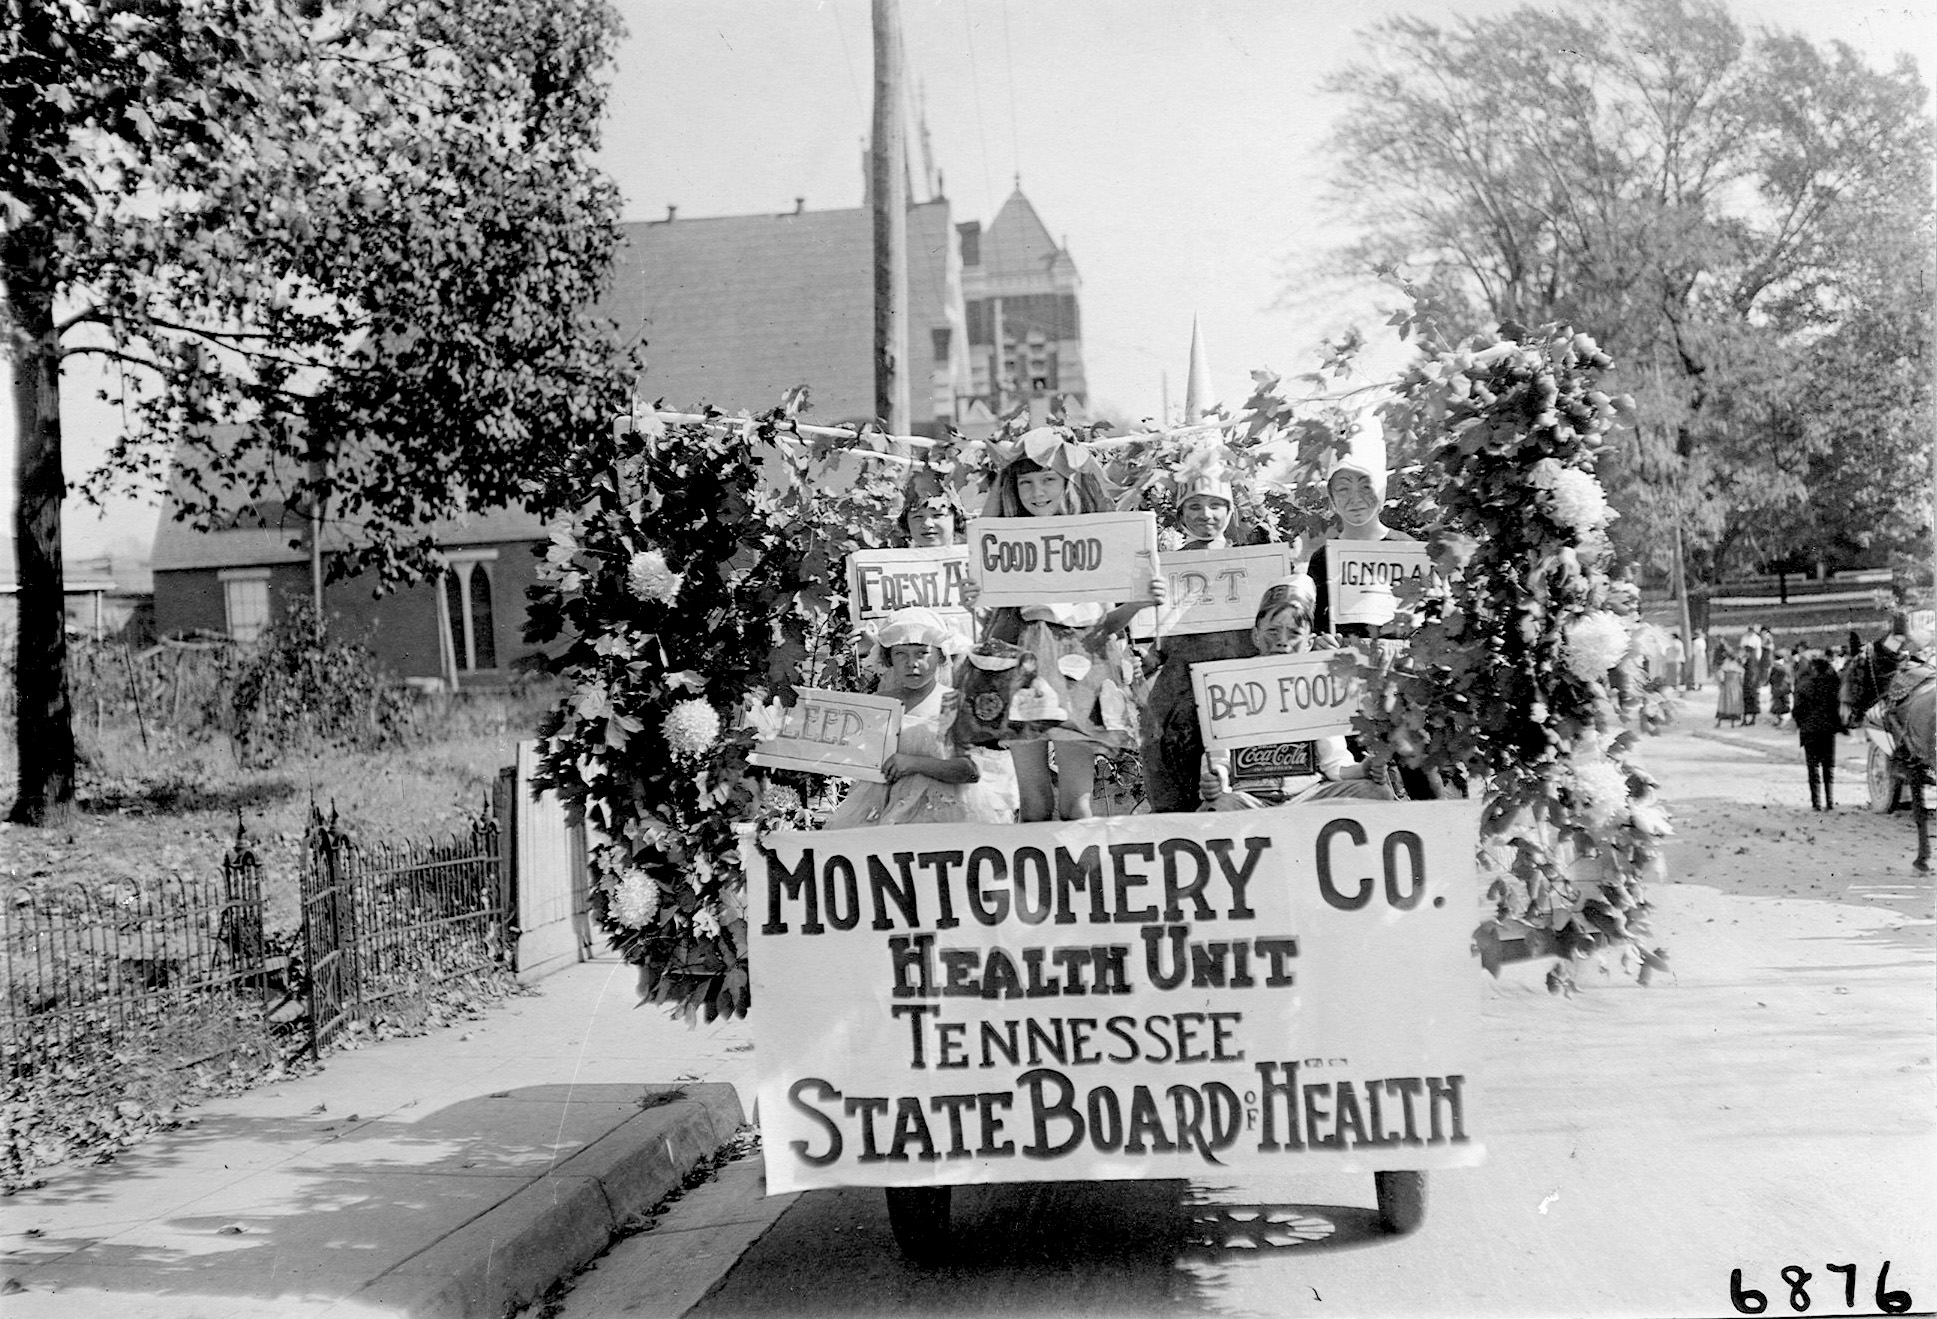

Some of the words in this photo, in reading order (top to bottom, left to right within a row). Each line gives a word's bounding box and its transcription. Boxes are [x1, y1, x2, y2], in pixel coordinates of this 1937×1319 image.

[981, 533, 1038, 573] GOOD
[1040, 534, 1103, 573] FOOD
[858, 566, 939, 611] FRESH
[1168, 567, 1249, 610] IRT
[1207, 681, 1268, 721] BAD
[1277, 673, 1349, 713] FOOD
[776, 704, 864, 746] LEEP
[760, 836, 1273, 936] MONTGOMERY
[1315, 817, 1446, 912] CO.
[887, 931, 1133, 1000] HEALTH
[1140, 924, 1299, 991] UNIT
[891, 1004, 1248, 1070] TENNESSEE
[788, 1077, 1016, 1168] STATE
[1015, 1067, 1243, 1167] BOARD
[1254, 1060, 1470, 1153] HEALTH
